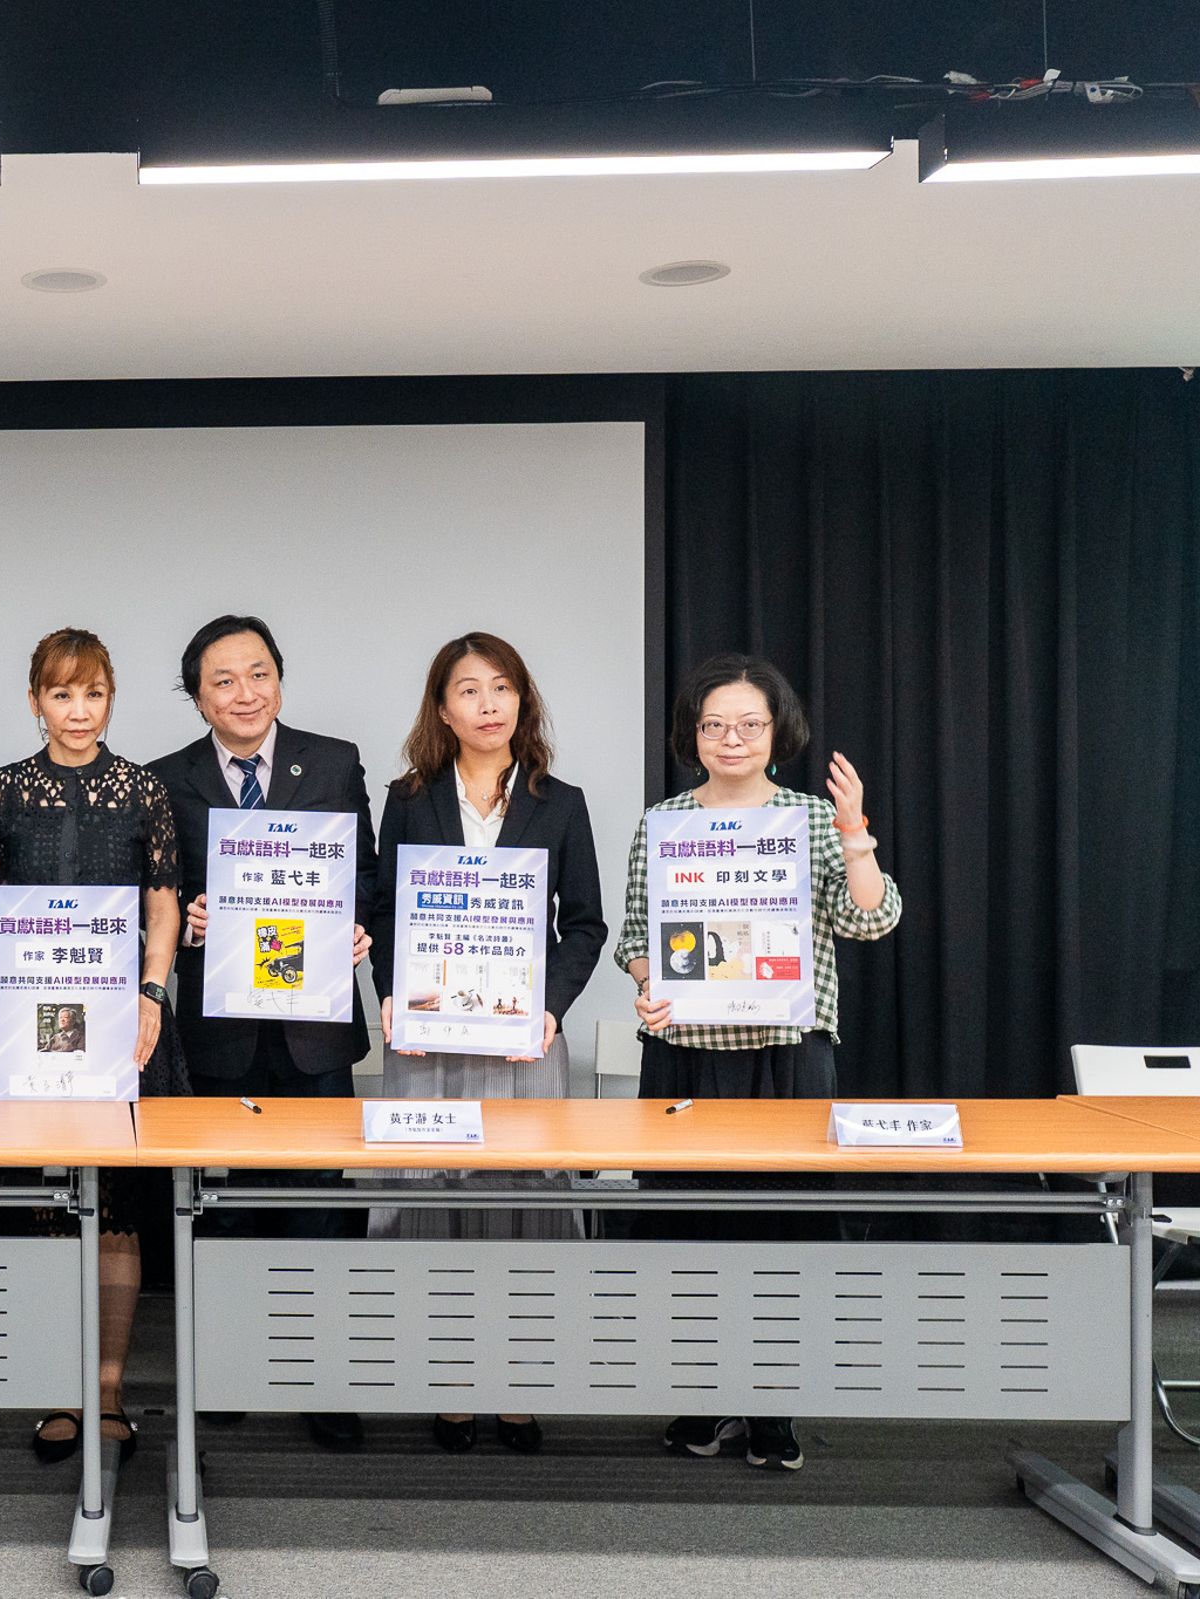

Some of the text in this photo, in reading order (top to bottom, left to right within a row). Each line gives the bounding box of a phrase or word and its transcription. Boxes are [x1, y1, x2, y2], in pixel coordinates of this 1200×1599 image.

[219, 838, 345, 859] 貢獻語料一起來
[659, 837, 796, 858] 貢獻語料一起來
[242, 870, 320, 886] 作家 藍弋丰
[410, 869, 535, 889] 貢獻語料一起來
[675, 869, 787, 883] INK 印刻文學
[219, 896, 343, 908] 願意共同支援AI模型發展與應用
[470, 897, 524, 910] 秀威資訊
[661, 897, 798, 907] 願意共同支援AI模型發展與應用
[410, 913, 534, 924] 願意共同支援AI模型發展與應用
[0, 917, 127, 935] 貢獻語料一起來
[23, 948, 103, 964] 作家 李魁賢
[417, 943, 526, 956] 提供 58 本作品簡介
[0, 976, 127, 984] 願意共同支援AI模型發展與應用
[432, 1113, 456, 1124] 女士
[907, 1120, 932, 1131] 作家
